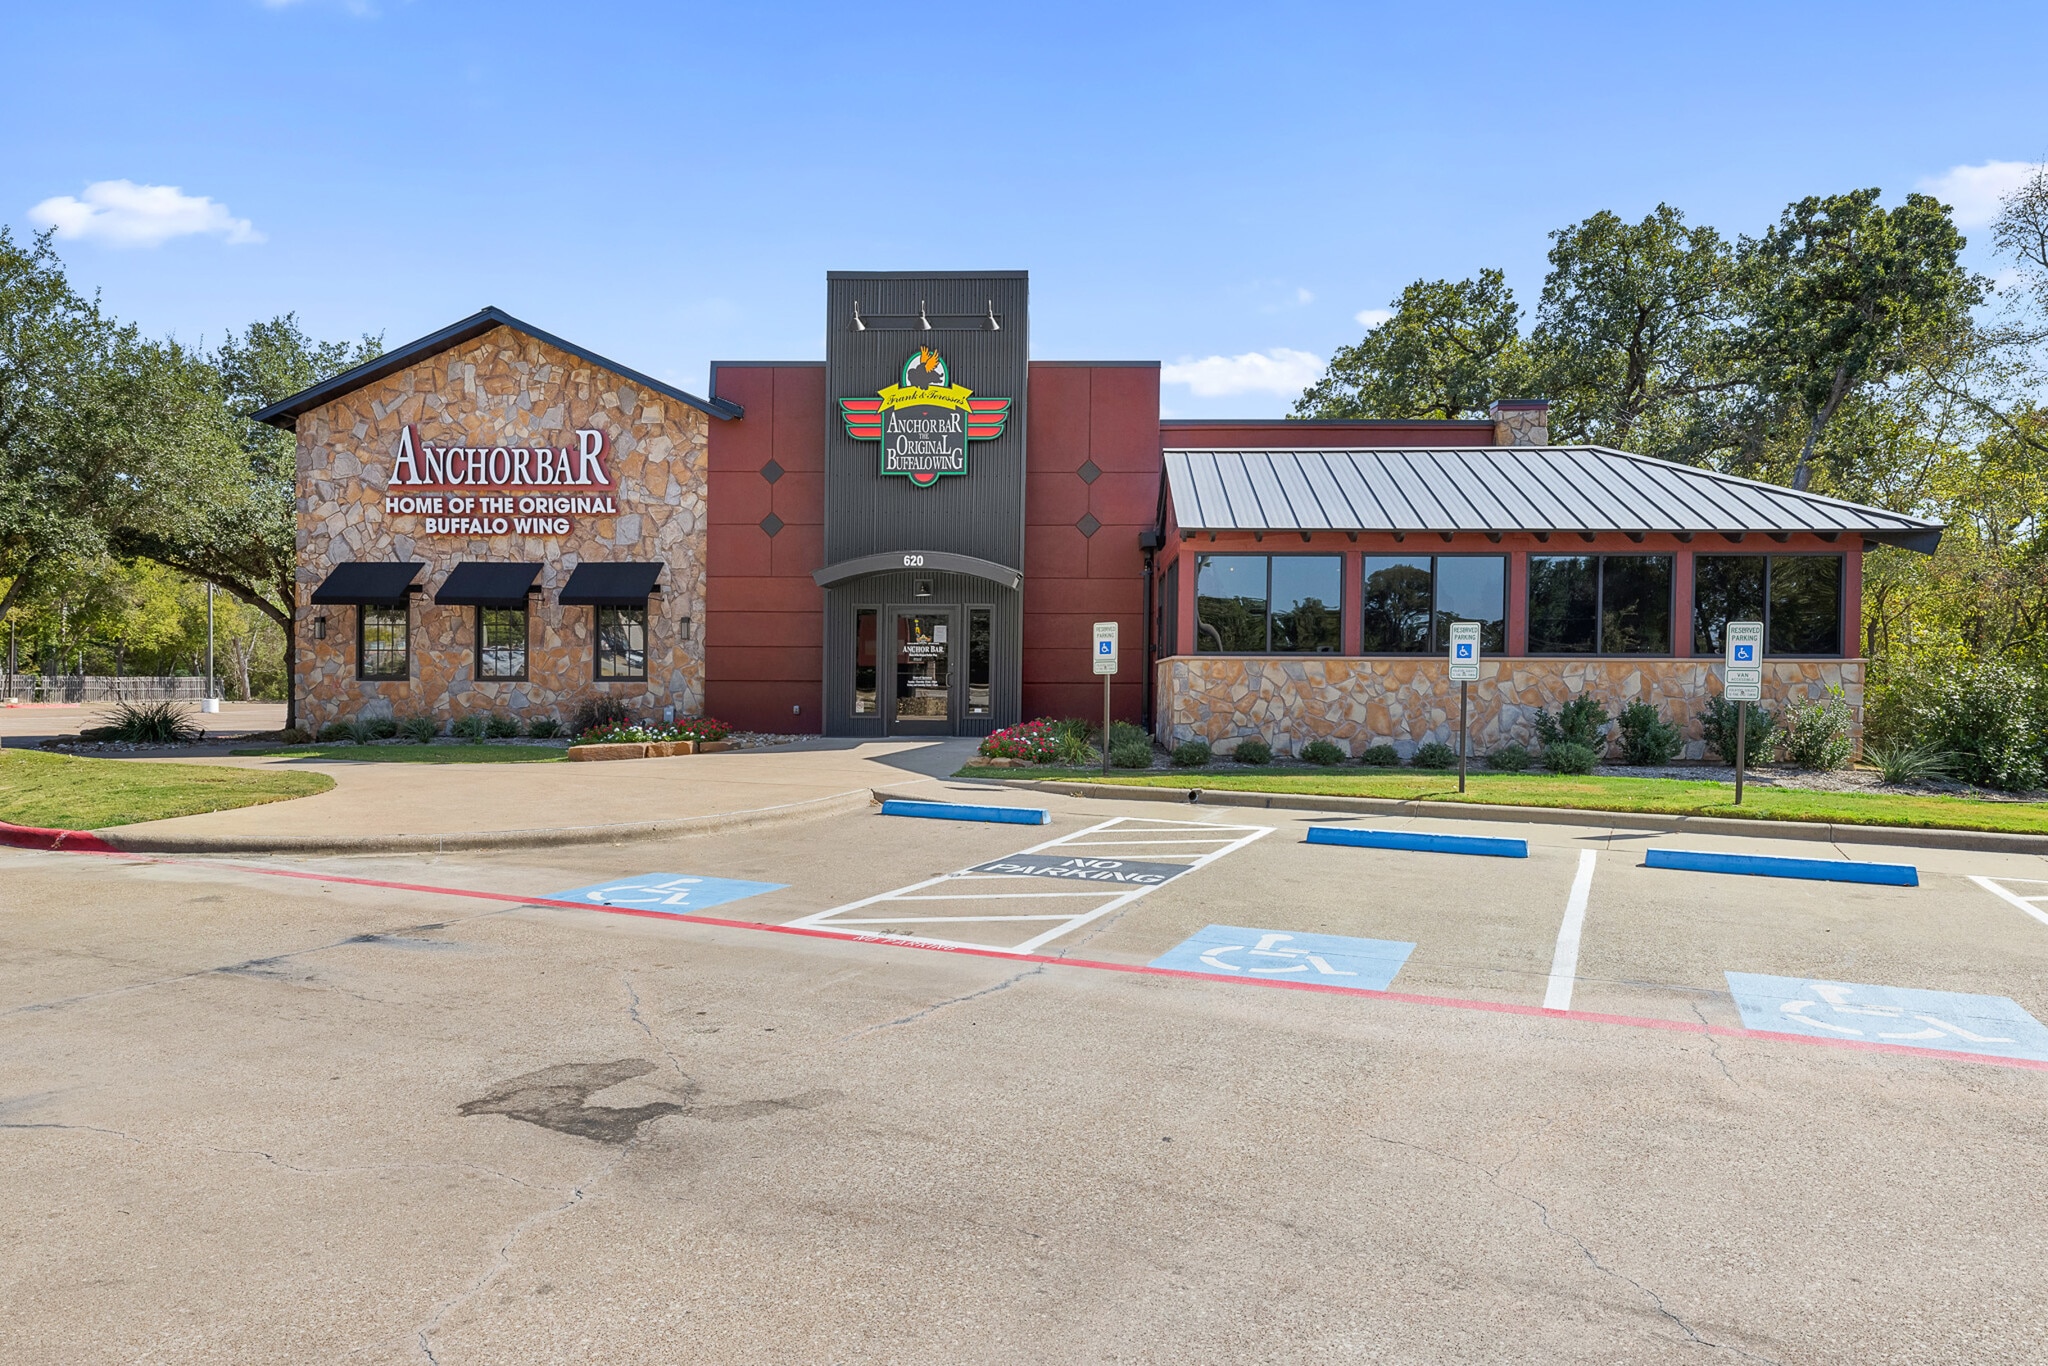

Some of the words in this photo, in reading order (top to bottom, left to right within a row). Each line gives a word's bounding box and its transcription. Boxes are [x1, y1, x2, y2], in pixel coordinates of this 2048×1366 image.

[887, 390, 918, 405] Frank
[918, 391, 926, 399] &
[896, 434, 952, 456] ORIGINAL
[385, 497, 444, 514] HOME
[448, 497, 476, 514] OF
[479, 497, 515, 514] THE
[518, 497, 617, 514] ORIGINAL
[425, 517, 509, 534] BUFFALO
[513, 518, 571, 535] WING
[903, 555, 924, 567] 620
[1731, 626, 1760, 634] RESERVED
[902, 645, 930, 653] ANCHOR
[1061, 858, 1123, 869] NO
[983, 863, 1166, 883] PARKING
[881, 938, 960, 951] PARKING
